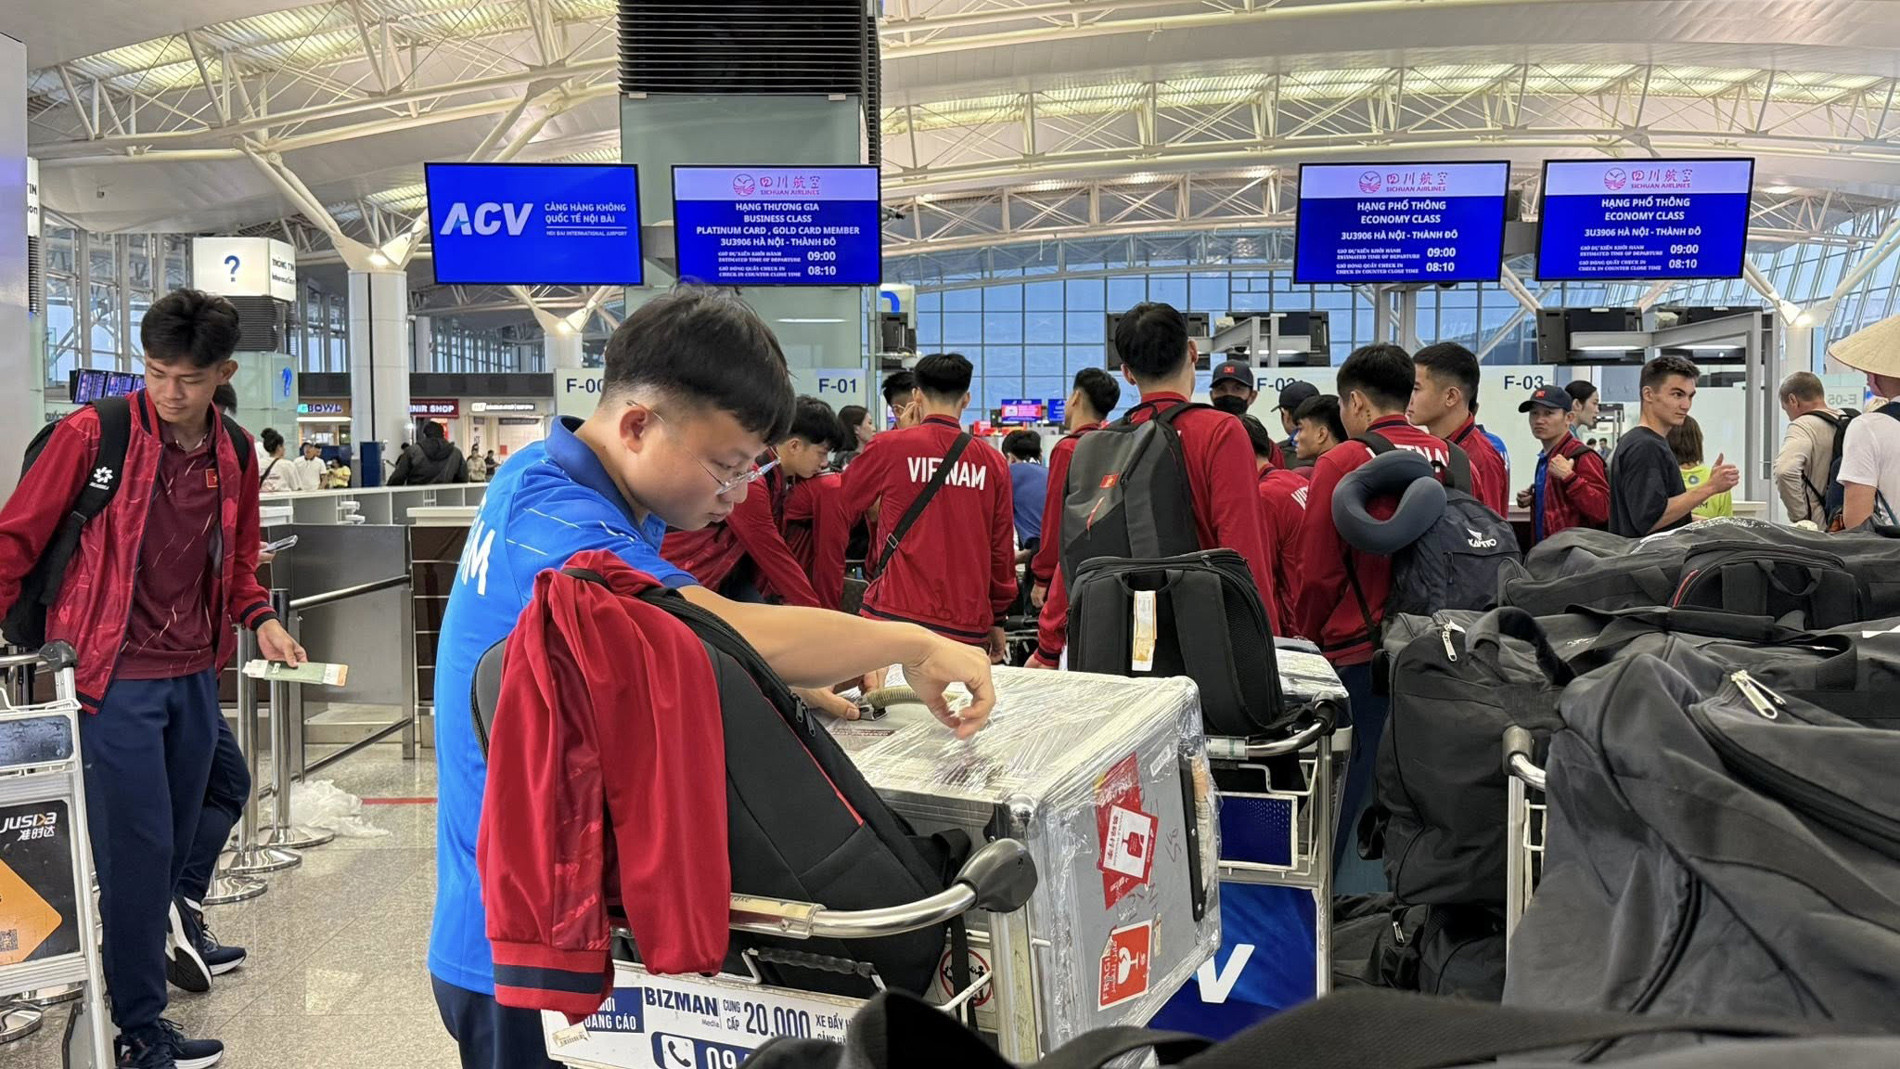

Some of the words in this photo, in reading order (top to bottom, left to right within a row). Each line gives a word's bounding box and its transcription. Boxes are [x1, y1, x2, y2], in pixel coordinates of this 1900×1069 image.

[1386, 172, 1448, 185] 四川航空
[1632, 169, 1692, 182] 四川航空
[760, 176, 820, 188] 四川航空
[570, 201, 594, 211] HÀNG
[596, 202, 626, 212] KHÔNG
[736, 203, 761, 212] HẠNG
[804, 203, 819, 211] GIA
[1357, 202, 1386, 212] HẠNG
[1388, 199, 1409, 210] PHỔ
[1412, 200, 1446, 210] THÔNG
[1602, 198, 1630, 209] HẠNG
[1632, 196, 1653, 207] PHỔ
[1656, 196, 1690, 207] THÔNG
[440, 202, 534, 236] ACV
[545, 212, 568, 224] QUỐC
[571, 212, 581, 223] TẾ
[583, 214, 598, 225] NỘI
[601, 214, 615, 223] BÀI
[744, 215, 785, 223] BUSINESS
[786, 215, 812, 223] CLASS
[1361, 215, 1410, 224] ECONOMY
[1412, 214, 1441, 223] CLASS
[1605, 212, 1654, 220] ECONOMY
[1656, 211, 1685, 220] CLASS
[1341, 232, 1372, 240] 3U3906
[1374, 230, 1386, 240] HÀ
[1388, 230, 1406, 241] NỘI
[1412, 230, 1442, 239] THÀNH
[1584, 229, 1616, 237] 3U3906
[1618, 226, 1630, 236] HÀ
[1632, 226, 1649, 237] NỘI
[1656, 226, 1686, 236] THÀNH
[720, 238, 751, 246] 3U3906
[753, 237, 765, 246] HÀ
[767, 237, 784, 248] NỘI
[791, 237, 821, 246] THÀNH
[1427, 248, 1456, 257] 09:00
[1670, 244, 1699, 254] 09:00
[807, 251, 836, 261] 09:00
[1426, 262, 1455, 272] 08:10
[1669, 259, 1697, 269] 08:10
[808, 266, 836, 276] 08:10
[819, 378, 856, 393] F-01
[1504, 376, 1544, 390] F-03
[308, 404, 342, 412] BOWL
[430, 404, 454, 413] SHOP
[907, 456, 986, 490] VIENAM
[17, 825, 56, 841] 准时达
[1102, 956, 1110, 1000] FRAGI
[644, 986, 718, 1016] BIZMAN
[723, 999, 740, 1014] CUNG
[616, 1012, 636, 1030] CÁO
[727, 1016, 740, 1031] CẤP
[744, 1002, 812, 1040] 20.000
[815, 1014, 826, 1027] XE
